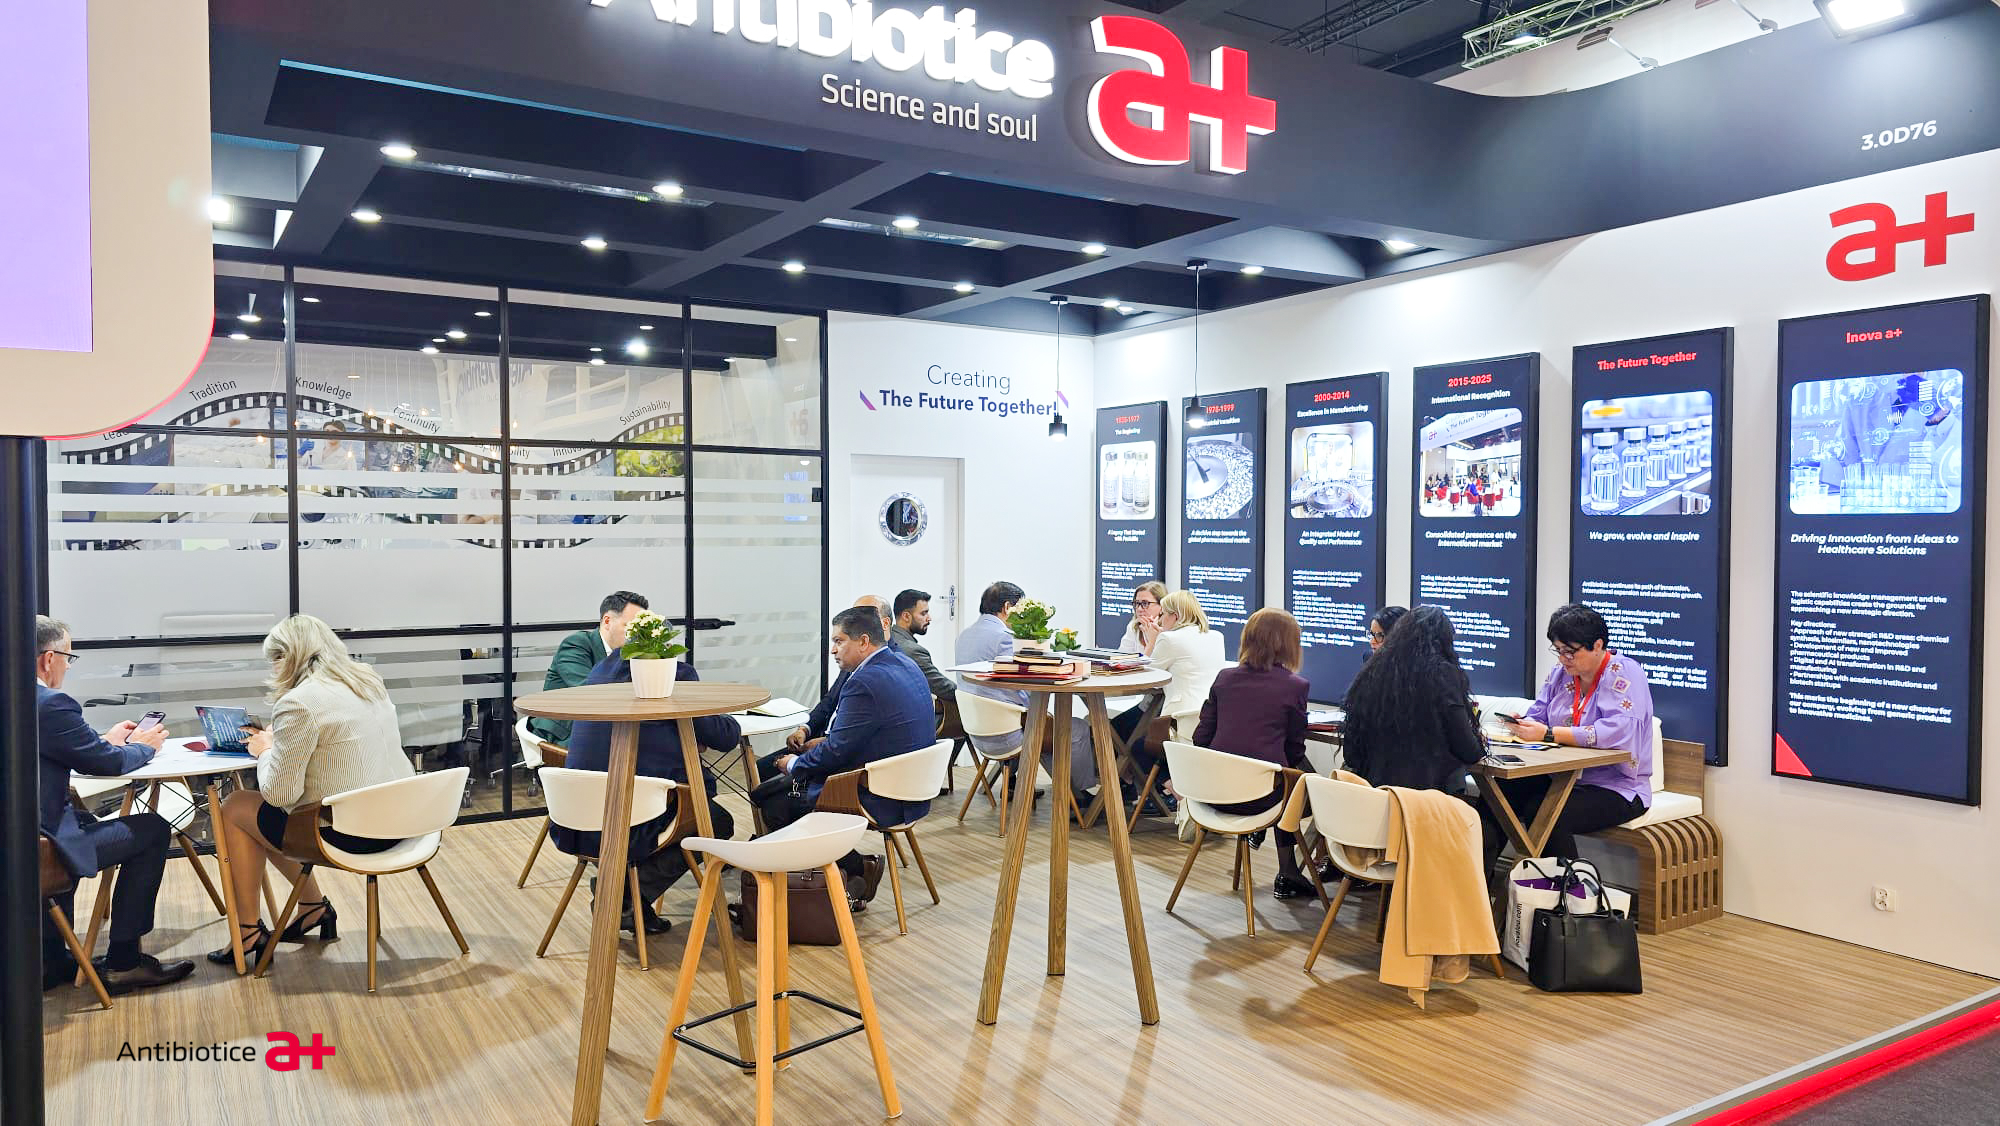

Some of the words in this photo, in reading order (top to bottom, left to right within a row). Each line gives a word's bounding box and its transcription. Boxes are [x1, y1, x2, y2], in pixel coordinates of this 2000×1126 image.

[821, 73, 925, 120] Science
[932, 102, 980, 131] and
[987, 113, 1038, 142] soul
[1861, 120, 1937, 150] 3.0D76
[1847, 330, 1882, 343] Inova
[1598, 360, 1616, 370] The
[1618, 358, 1648, 368] Future
[1650, 352, 1696, 366] Together
[295, 377, 352, 400] Knowledge
[927, 364, 1011, 395] Creating
[1448, 374, 1492, 388] 2015-2025
[190, 380, 237, 401] Tradition
[1314, 392, 1350, 402] 2000-2014
[620, 399, 671, 426] Sustainability
[879, 389, 912, 407] The
[918, 392, 974, 411] Future
[978, 396, 1057, 417] Together!
[394, 405, 450, 434] Continuity
[1590, 531, 1602, 540] We
[1626, 532, 1652, 541] evolve
[1653, 532, 1669, 541] and
[1791, 534, 1826, 544] Driving
[1885, 534, 1911, 544] from
[1946, 534, 1959, 544] to
[1817, 545, 1875, 554] Healthcare
[1876, 545, 1927, 555] Solutions
